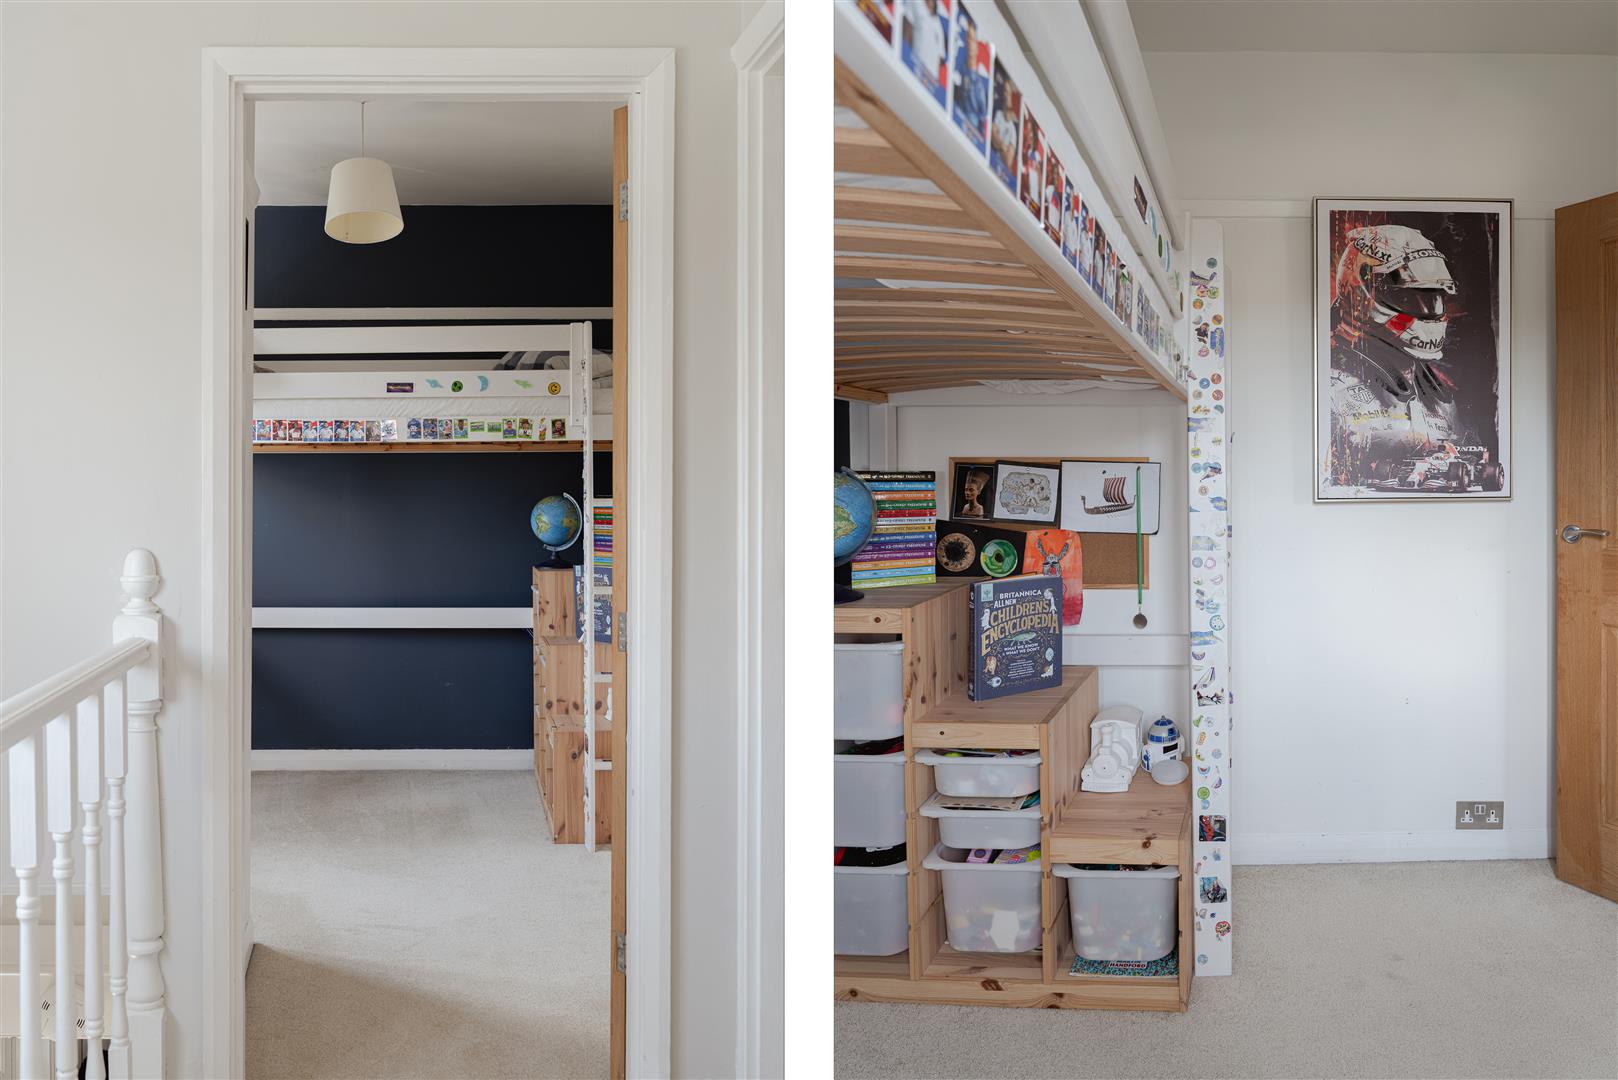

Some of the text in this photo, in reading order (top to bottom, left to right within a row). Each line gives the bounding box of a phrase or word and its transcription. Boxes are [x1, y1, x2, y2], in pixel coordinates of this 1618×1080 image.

[1453, 445, 1484, 453] ONDA
[999, 589, 1042, 600] BRITANNICA
[990, 599, 1050, 626] CHILDREN'S
[981, 614, 1059, 656] ENCYCLOPEDIA
